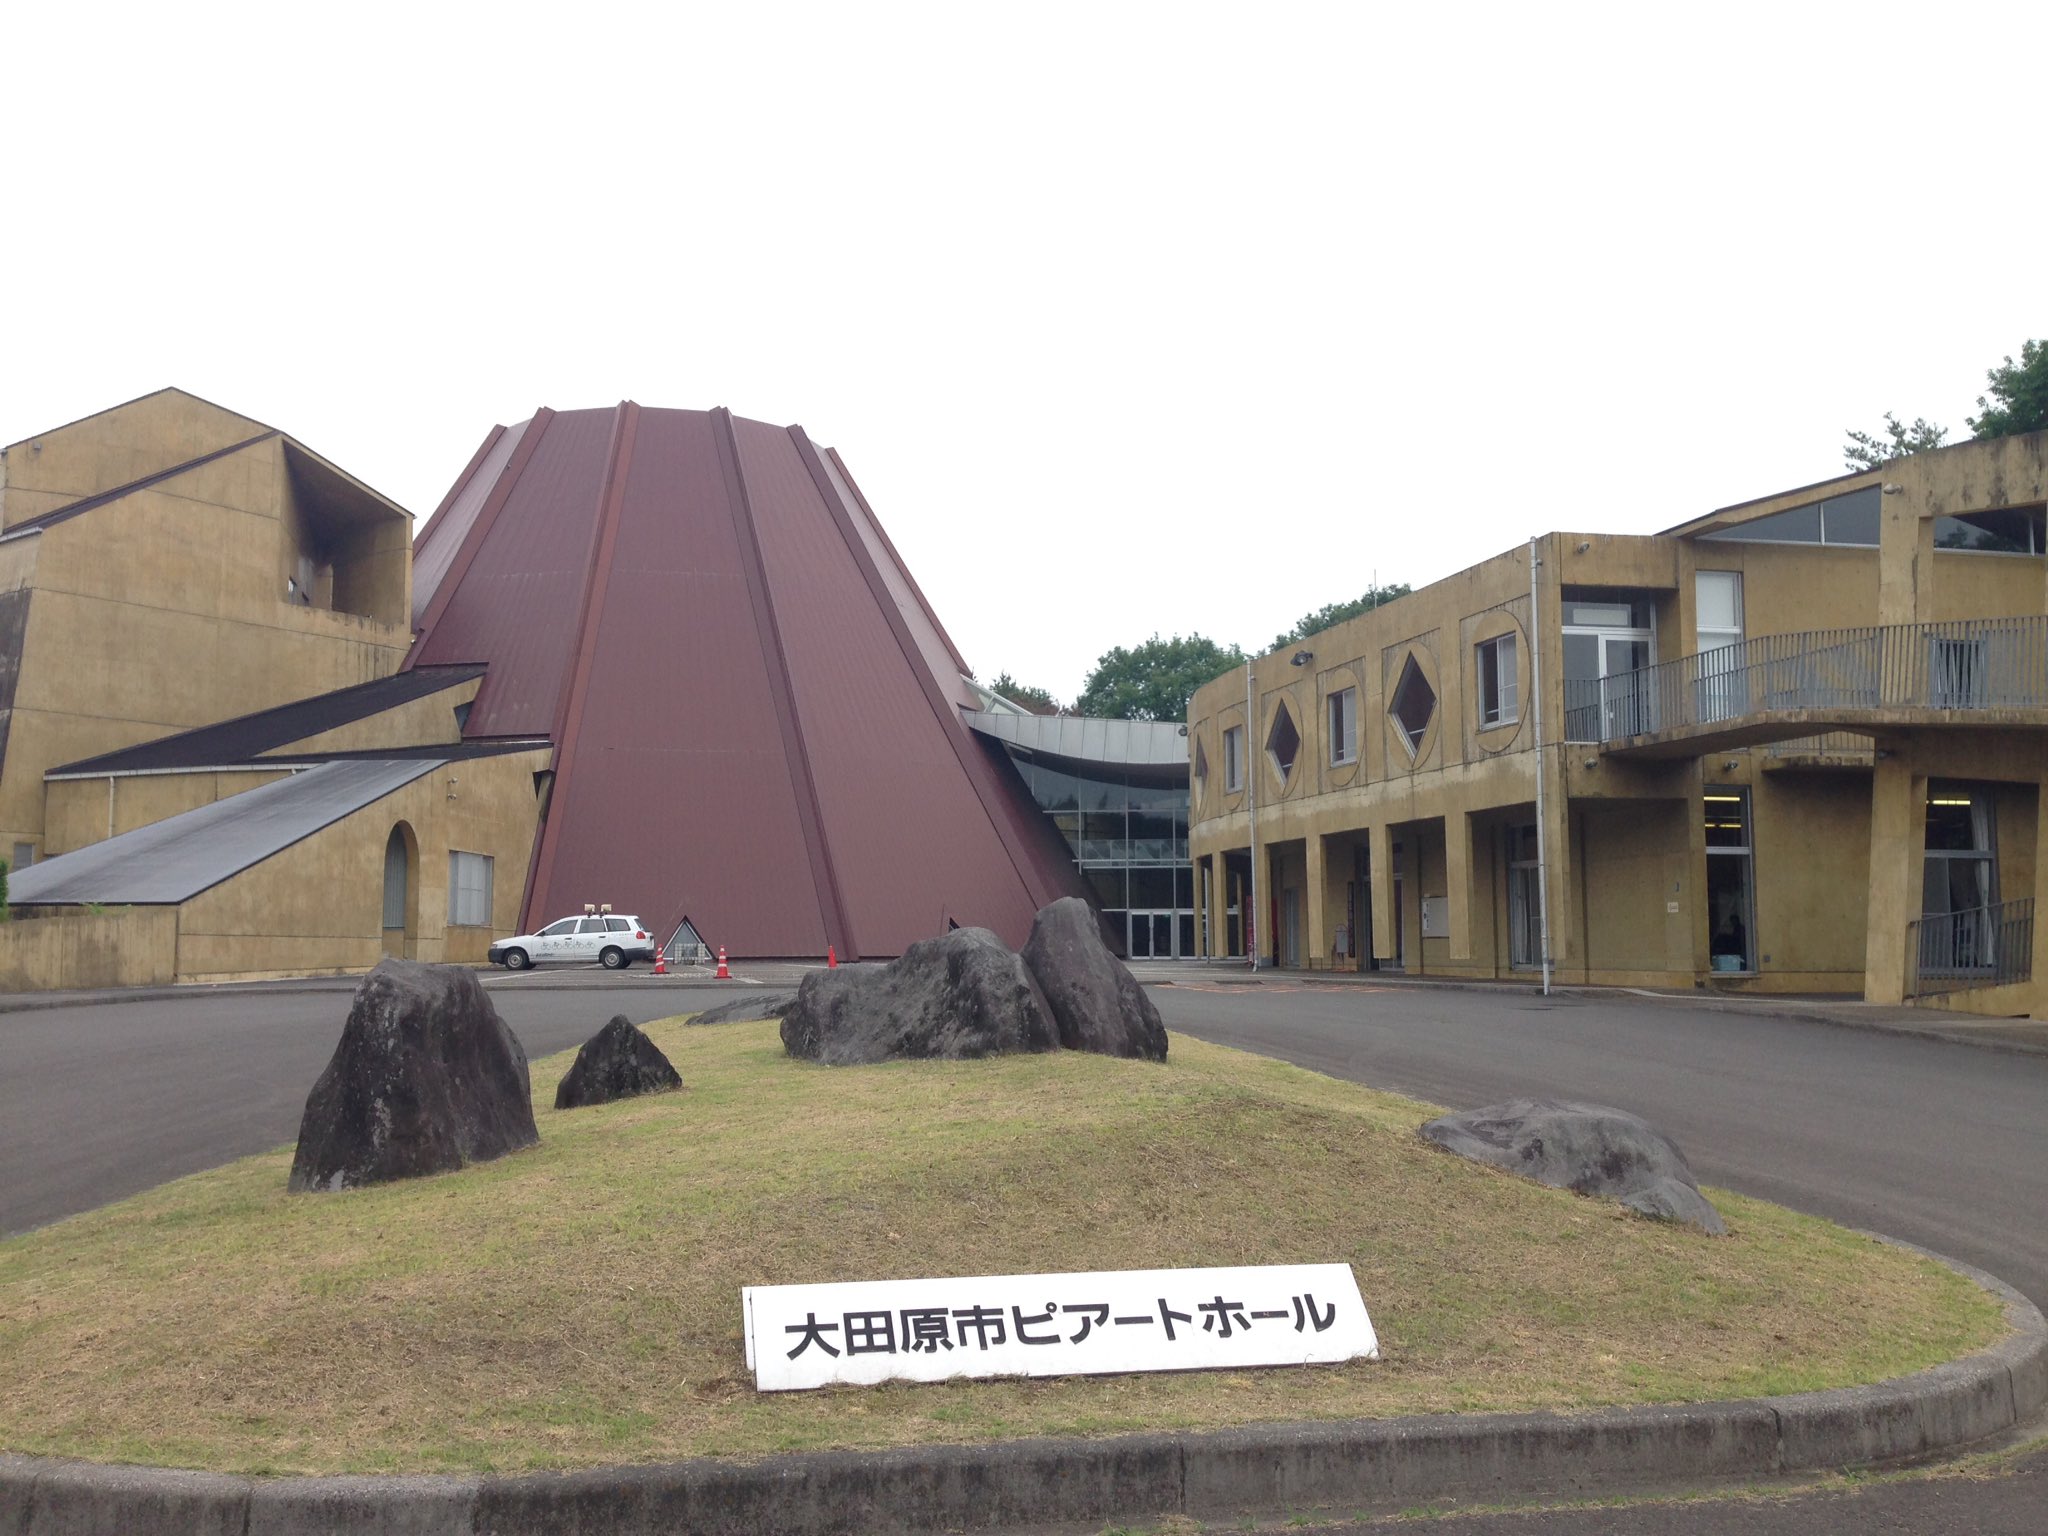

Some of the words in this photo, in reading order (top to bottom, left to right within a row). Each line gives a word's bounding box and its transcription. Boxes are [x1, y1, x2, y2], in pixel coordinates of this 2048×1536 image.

[784, 1293, 1336, 1359] 大田原市ピアートホール
